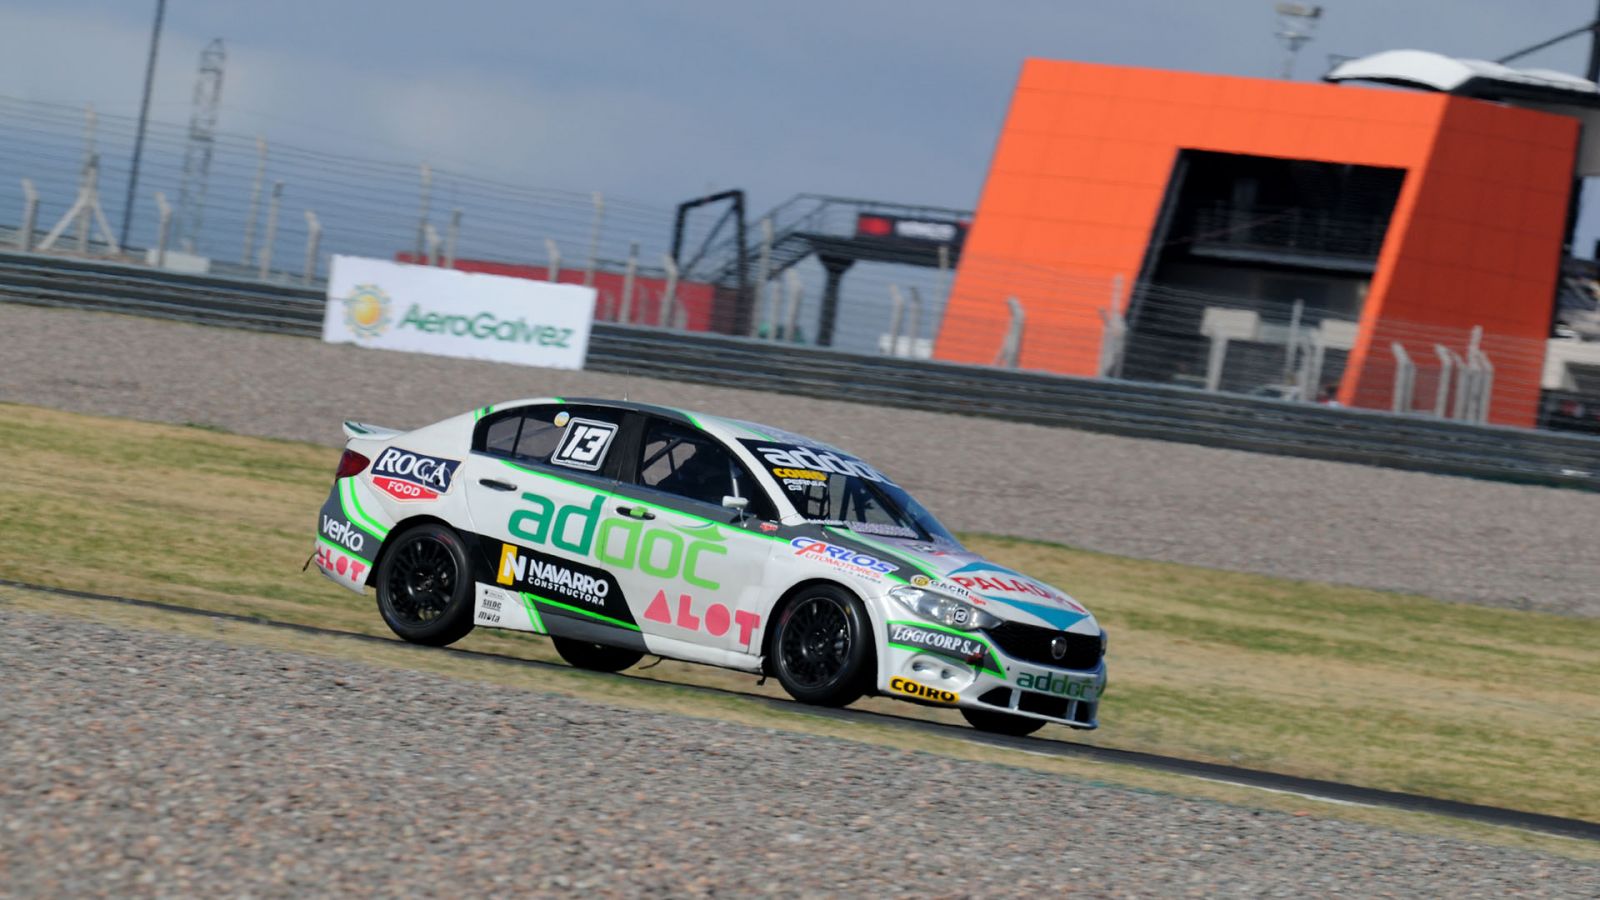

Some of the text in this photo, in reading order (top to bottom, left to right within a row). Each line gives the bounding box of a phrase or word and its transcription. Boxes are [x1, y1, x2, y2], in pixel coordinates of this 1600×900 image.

[399, 302, 574, 348] AeroGalvez
[561, 425, 612, 461] 13
[376, 448, 446, 487] ROCA
[387, 481, 421, 496] FOOD
[322, 514, 364, 551] verko
[508, 492, 728, 590] addoc
[791, 540, 897, 574] CARLOS
[528, 559, 609, 598] NAVARRO
[528, 577, 605, 606] CONSTRUCTORA
[893, 627, 962, 651] LOGICORP
[890, 678, 956, 701] COIRO
